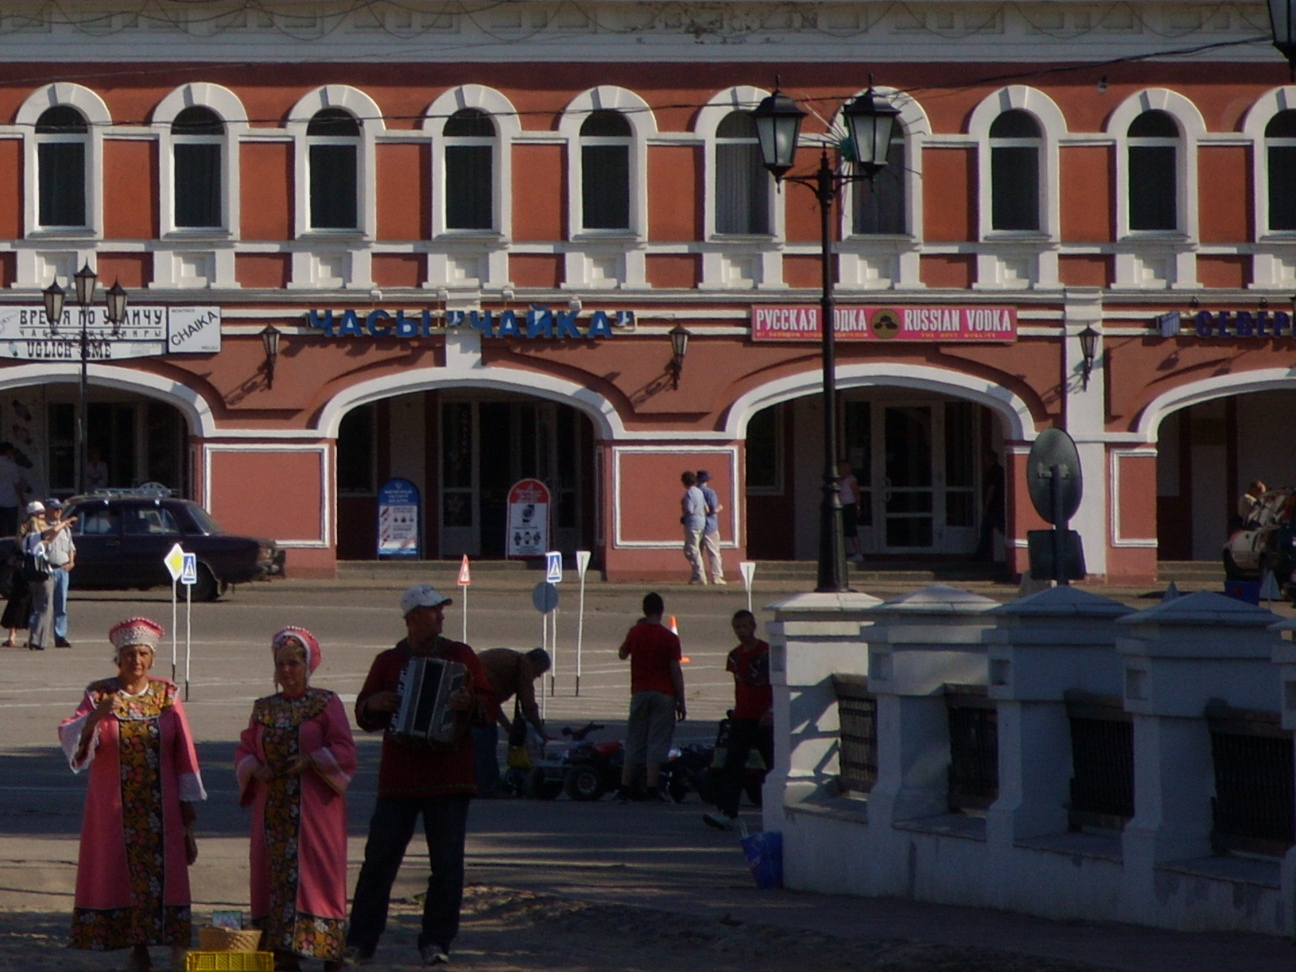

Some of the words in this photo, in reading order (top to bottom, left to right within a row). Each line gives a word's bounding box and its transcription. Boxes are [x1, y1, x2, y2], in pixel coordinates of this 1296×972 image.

[20, 310, 71, 325] ВРЕЯ
[103, 310, 162, 325] УЛИЧУ
[171, 310, 218, 346] CHAIKA
[308, 309, 431, 338] ЧАСЫ
[756, 309, 817, 331] РУССКАЯ
[830, 309, 867, 332] ОДКА
[904, 309, 960, 332] RUSSIAN
[966, 309, 1011, 332] VODKA
[1195, 309, 1296, 338] СЕВЕР
[27, 341, 72, 358] UGLICH
